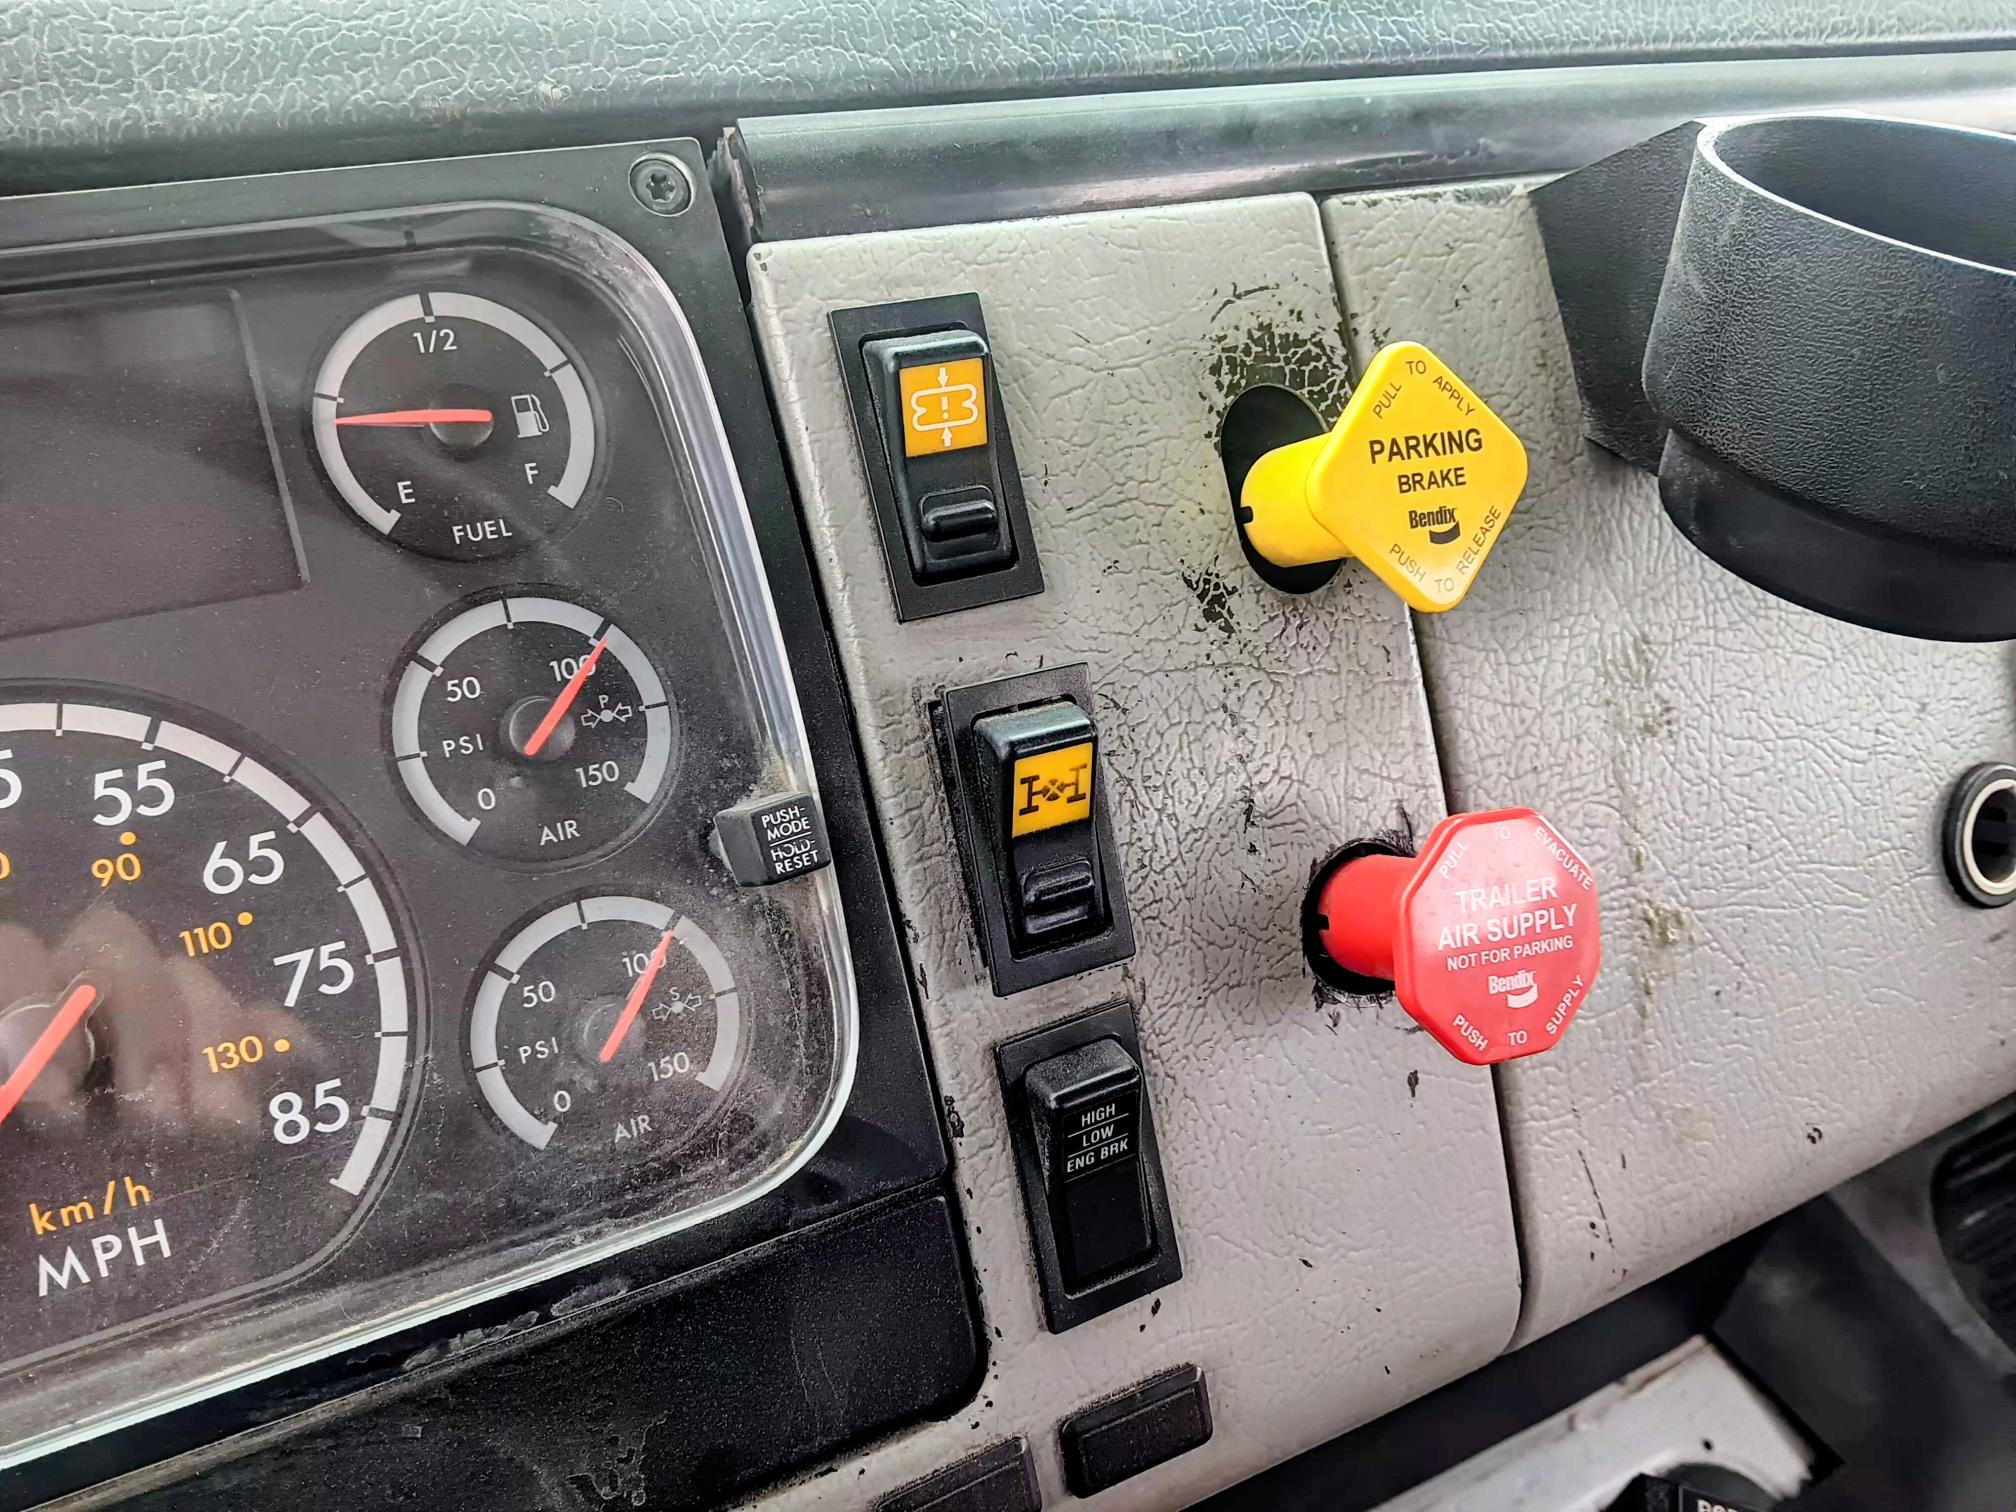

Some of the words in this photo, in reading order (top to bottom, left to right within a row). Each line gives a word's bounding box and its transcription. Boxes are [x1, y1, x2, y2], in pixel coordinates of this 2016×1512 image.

[413, 329, 457, 353] 1/2
[1372, 382, 1402, 419] PULL
[1405, 360, 1427, 376] TO
[1432, 375, 1476, 417] APPLY
[1368, 428, 1483, 465] PARKING
[524, 462, 540, 485] F
[1397, 466, 1467, 494] BRAKE
[397, 480, 417, 505] E
[452, 517, 513, 545] FUEL
[1408, 505, 1458, 530] Bendix
[1389, 543, 1427, 584] PUSH
[1434, 577, 1455, 594] TO
[1455, 504, 1502, 576] RELEASE
[549, 654, 597, 682] 100
[445, 675, 482, 702] 50
[598, 694, 609, 709] P
[441, 735, 484, 759] PSI
[575, 760, 620, 788] 150
[92, 759, 176, 827] 55
[477, 786, 496, 811] 0
[540, 819, 581, 846] AIR
[766, 816, 811, 841] MODE
[91, 852, 142, 888] 90
[202, 830, 285, 895] 65
[774, 850, 818, 875] RESET
[1438, 841, 1470, 880] PULL
[1533, 824, 1594, 891] EVACUATE
[1455, 876, 1558, 914] TRAILER
[179, 920, 233, 957] 110
[1438, 922, 1481, 951] AIR
[1486, 903, 1578, 942] SUPPLY
[622, 949, 667, 978] 100
[1446, 952, 1478, 972] NOT
[1481, 947, 1511, 966] FOR
[1513, 934, 1574, 960] PARKING
[273, 940, 355, 1008] 75
[1487, 970, 1537, 995] Bendix
[522, 980, 556, 1009] 50
[1451, 1014, 1489, 1052] PUSH
[1507, 1030, 1528, 1046] TO
[1545, 973, 1585, 1035] SUPPLY
[202, 1035, 264, 1074] 130
[518, 1036, 559, 1064] PSI
[648, 1051, 690, 1082] 150
[267, 1078, 350, 1145] 85
[552, 1089, 572, 1113] 0
[1081, 1103, 1116, 1127] HIGH
[613, 1114, 654, 1144] AIR
[1082, 1123, 1114, 1147] LOW
[1066, 1151, 1095, 1173] ENG
[1100, 1138, 1129, 1160] BRK
[29, 1175, 152, 1236] km/h
[37, 1217, 173, 1297] MPH
